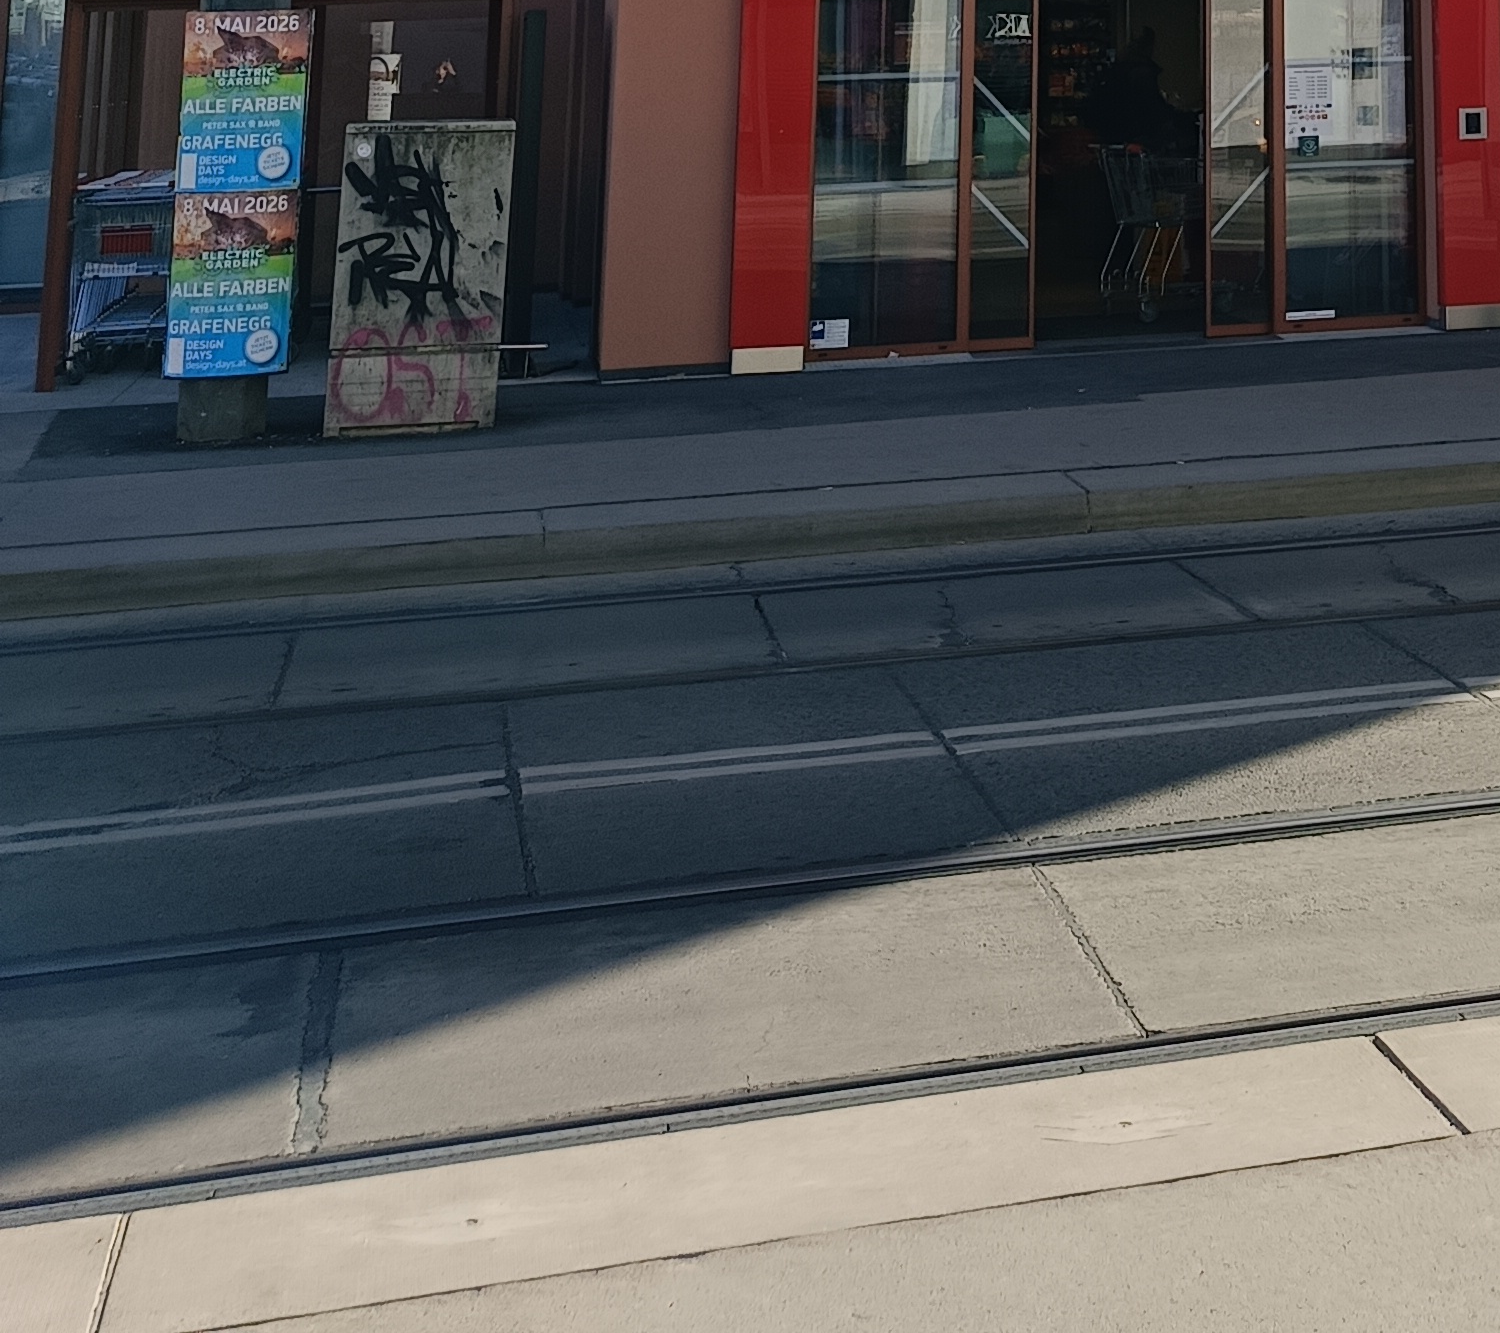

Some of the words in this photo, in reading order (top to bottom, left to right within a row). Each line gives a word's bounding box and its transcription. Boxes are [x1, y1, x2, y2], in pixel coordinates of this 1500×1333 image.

[194, 18, 210, 33] 8.
[214, 17, 250, 34] MAI
[256, 15, 300, 32] 2026
[214, 67, 277, 78] ELECTRIC
[218, 77, 271, 87] GARDEN
[183, 98, 227, 114] ALLE
[231, 96, 302, 113] FARBEN
[203, 121, 228, 129] PETER
[258, 119, 281, 128] BAND
[182, 132, 283, 150] GRAFENEGG
[199, 155, 237, 165] DESIGN
[198, 165, 225, 175] DAYS
[198, 175, 260, 186] design-days.at
[183, 199, 197, 215] 8.
[203, 197, 239, 215] MAI
[244, 195, 288, 214] 2026
[202, 249, 265, 260] ELECTRIC
[206, 259, 259, 269] GARDEN
[171, 281, 214, 298] ALLE
[219, 277, 289, 296] FARBEN
[190, 305, 215, 314] PETER
[217, 304, 234, 313] SAX
[245, 302, 269, 311] BAND
[170, 316, 271, 335] GRAFENEGG
[186, 339, 224, 350] DESIGN
[185, 351, 213, 360] DAYS
[186, 360, 247, 371] design-days.at
